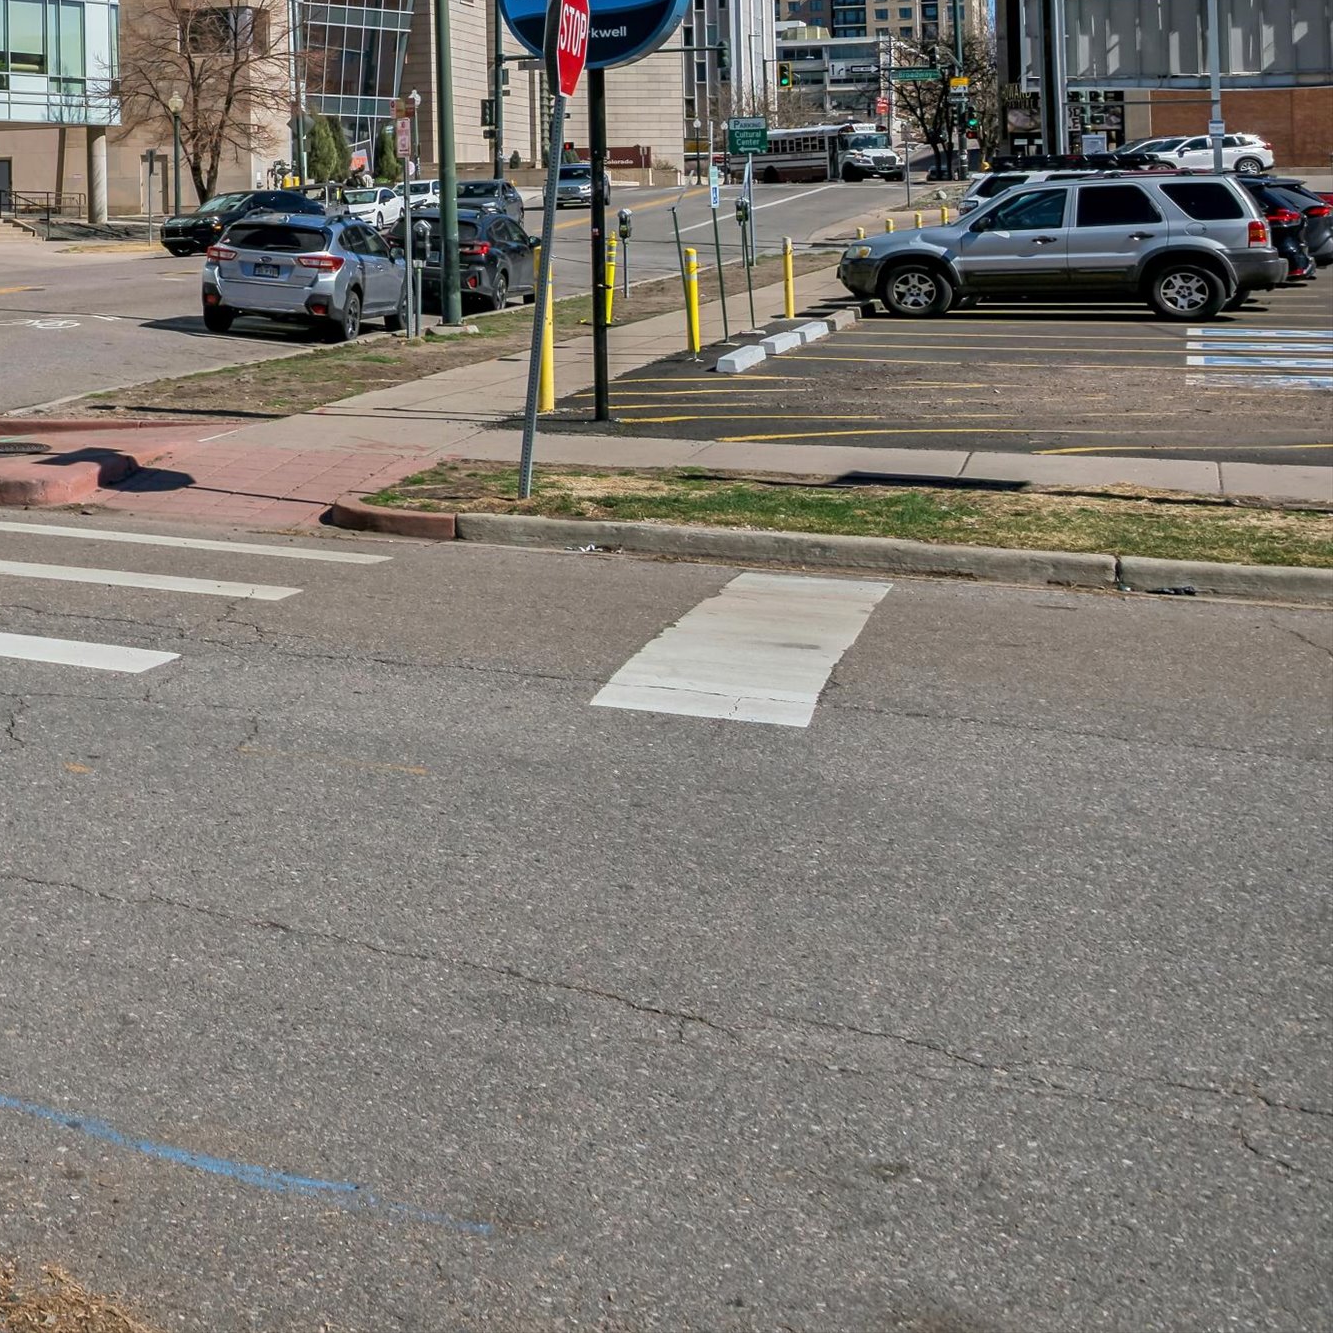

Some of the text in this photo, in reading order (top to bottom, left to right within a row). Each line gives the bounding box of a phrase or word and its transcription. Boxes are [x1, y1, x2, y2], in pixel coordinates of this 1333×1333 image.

[560, 3, 587, 57] STOP
[591, 26, 627, 38] kwell
[898, 70, 933, 79] Broadway
[734, 130, 762, 138] Cultural
[736, 138, 760, 146] Center
